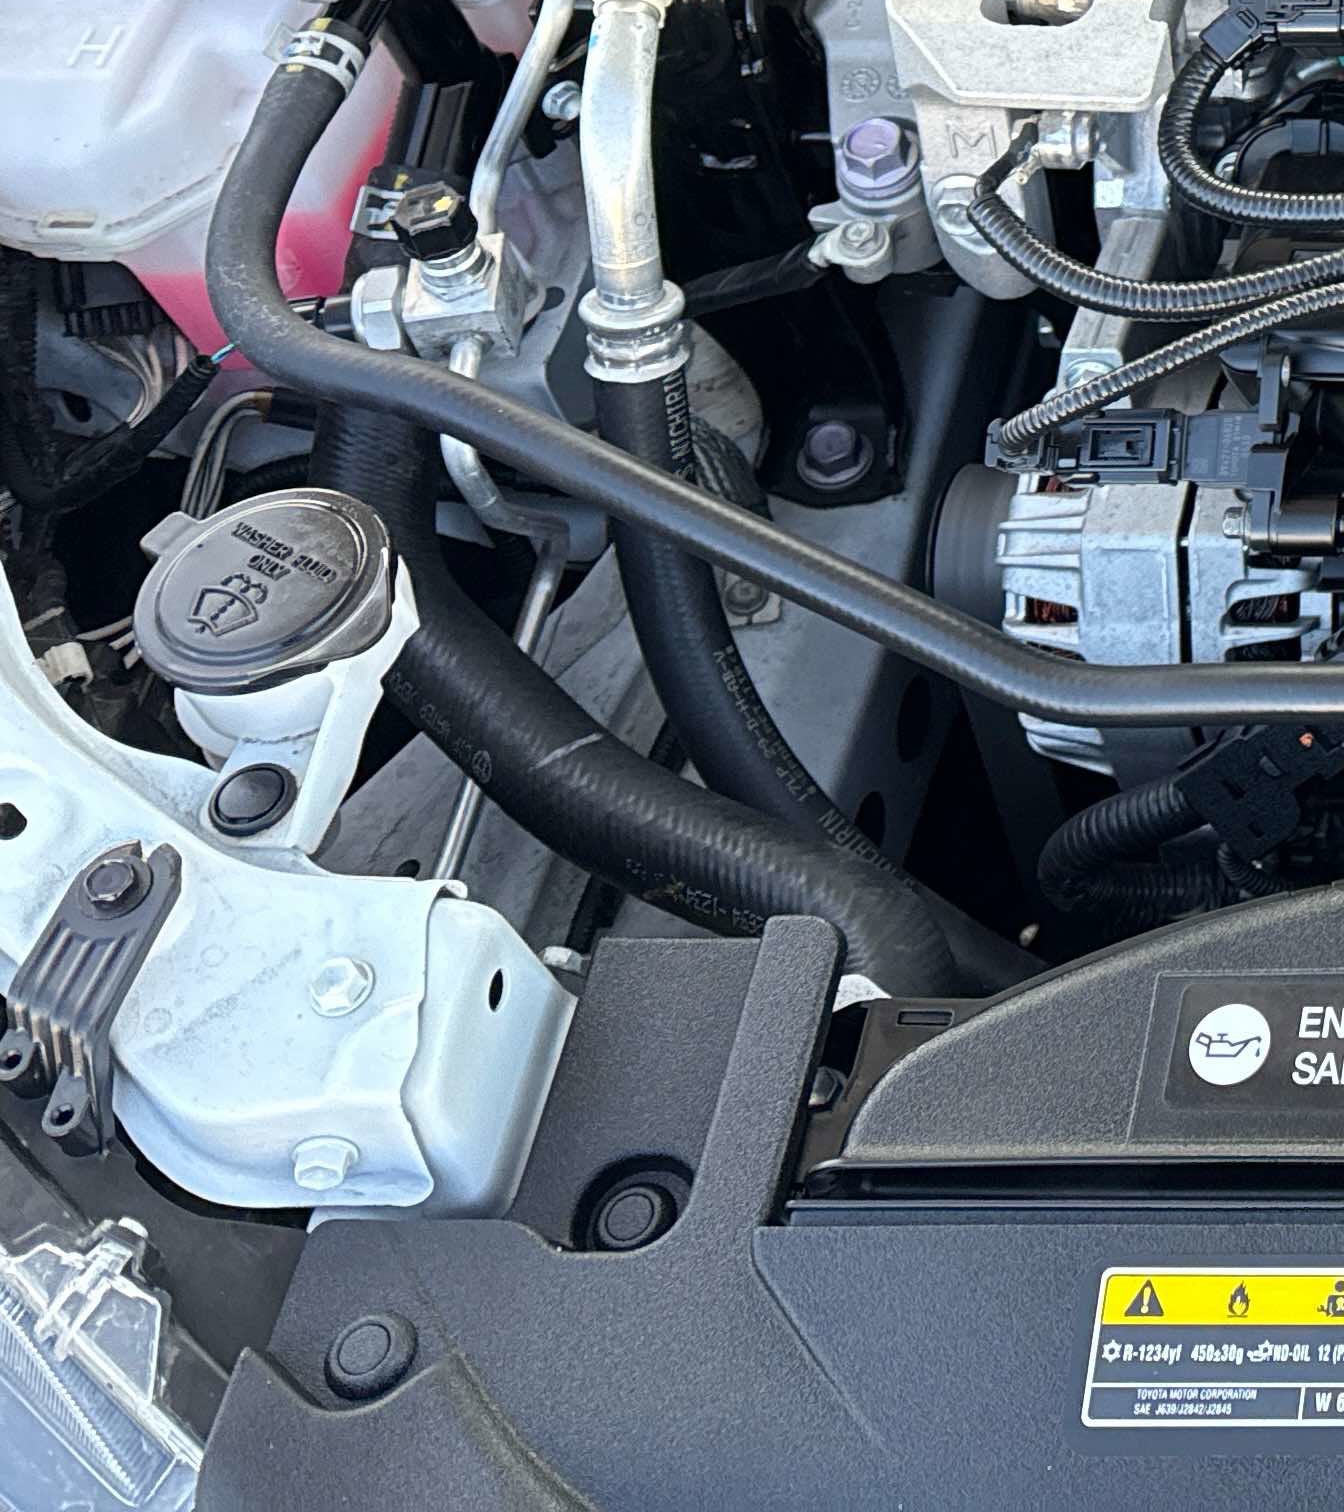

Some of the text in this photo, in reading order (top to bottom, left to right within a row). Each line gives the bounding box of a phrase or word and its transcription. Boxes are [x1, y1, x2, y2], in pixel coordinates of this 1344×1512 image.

[1122, 1344, 1182, 1365] R-1234yf
[1317, 1344, 1330, 1362] 12
[1136, 1388, 1257, 1400] TOYOTA MOTOR CORPORATION
[1133, 1403, 1151, 1415] SAE
